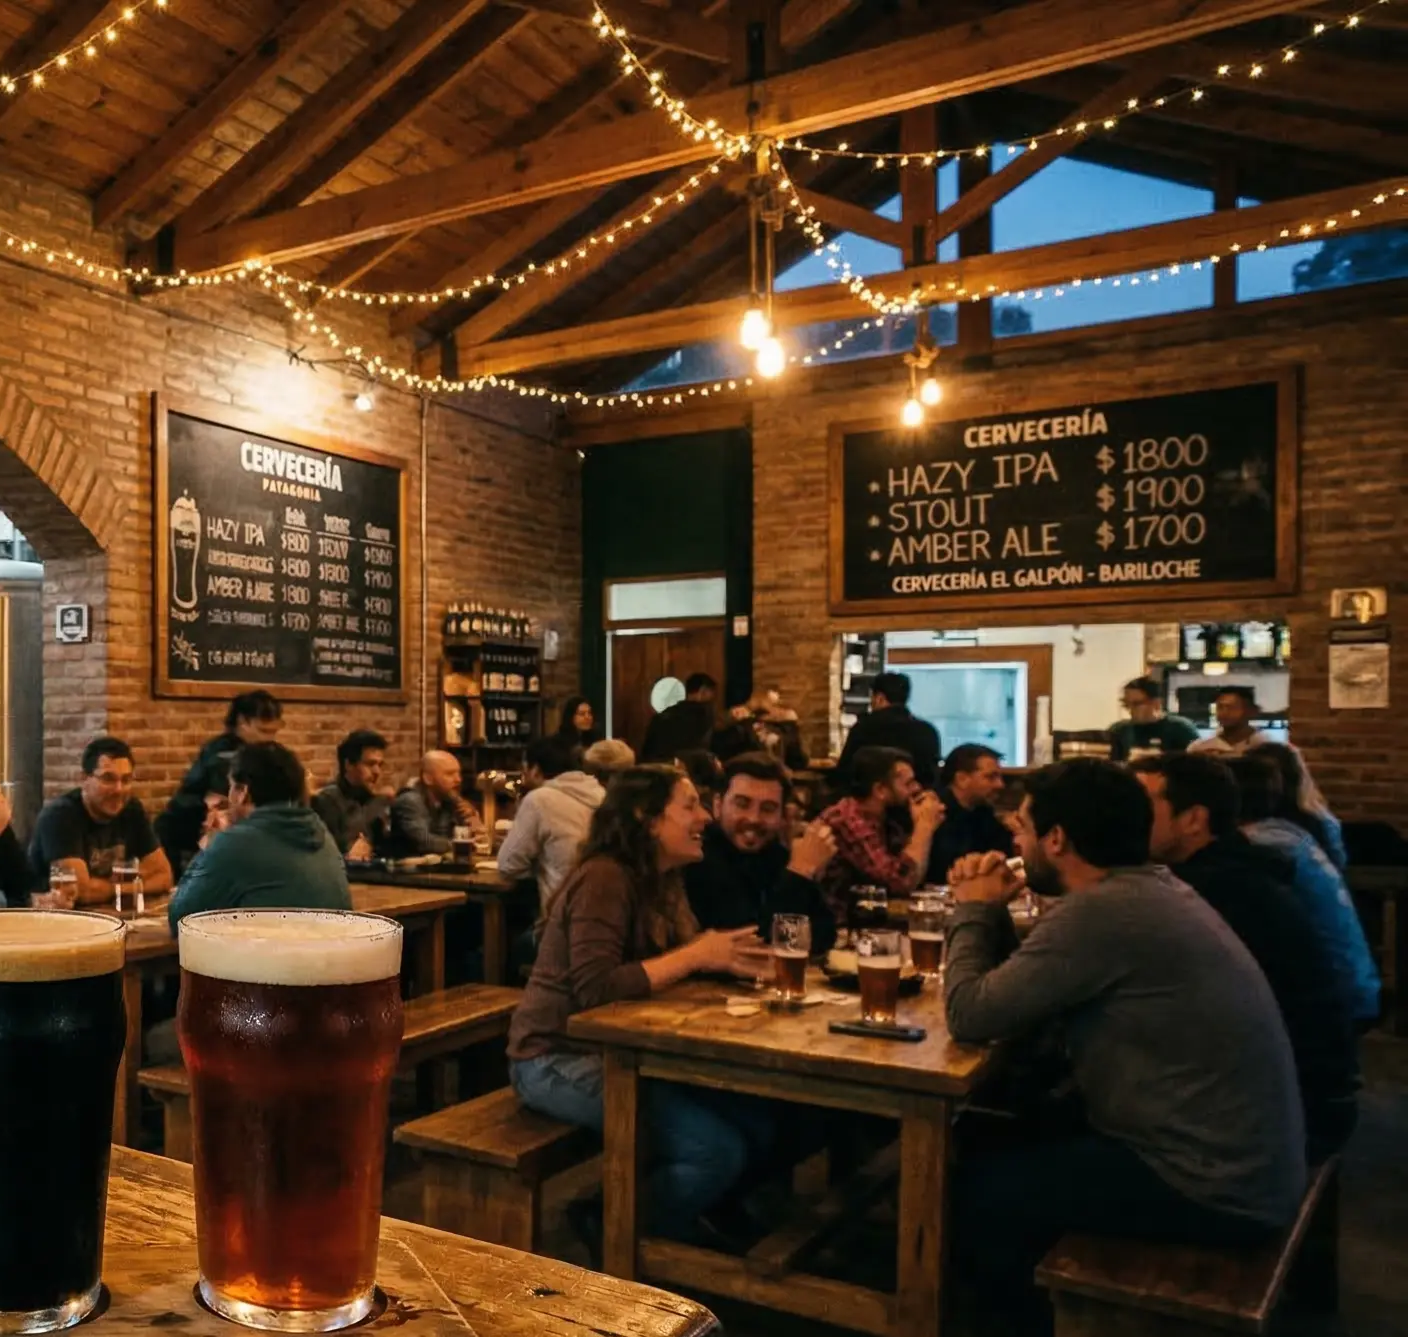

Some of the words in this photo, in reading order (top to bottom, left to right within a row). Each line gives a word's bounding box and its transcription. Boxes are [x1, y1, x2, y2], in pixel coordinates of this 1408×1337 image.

[964, 408, 1109, 449] CERVECERÍA
[240, 441, 344, 492] CERVECERÍA
[888, 461, 977, 498] HAZY
[993, 451, 1059, 488] IPA
[206, 515, 240, 542] HAZY
[244, 522, 266, 547] IPA
[888, 493, 993, 532] STOUT
[888, 529, 991, 567] AMBER
[1001, 522, 1062, 557] ALE
[892, 566, 988, 594] CERVECERÍA
[991, 570, 1012, 590] EL
[1013, 562, 1084, 588] GALPÓN
[1098, 558, 1202, 583] BARILOCHE
